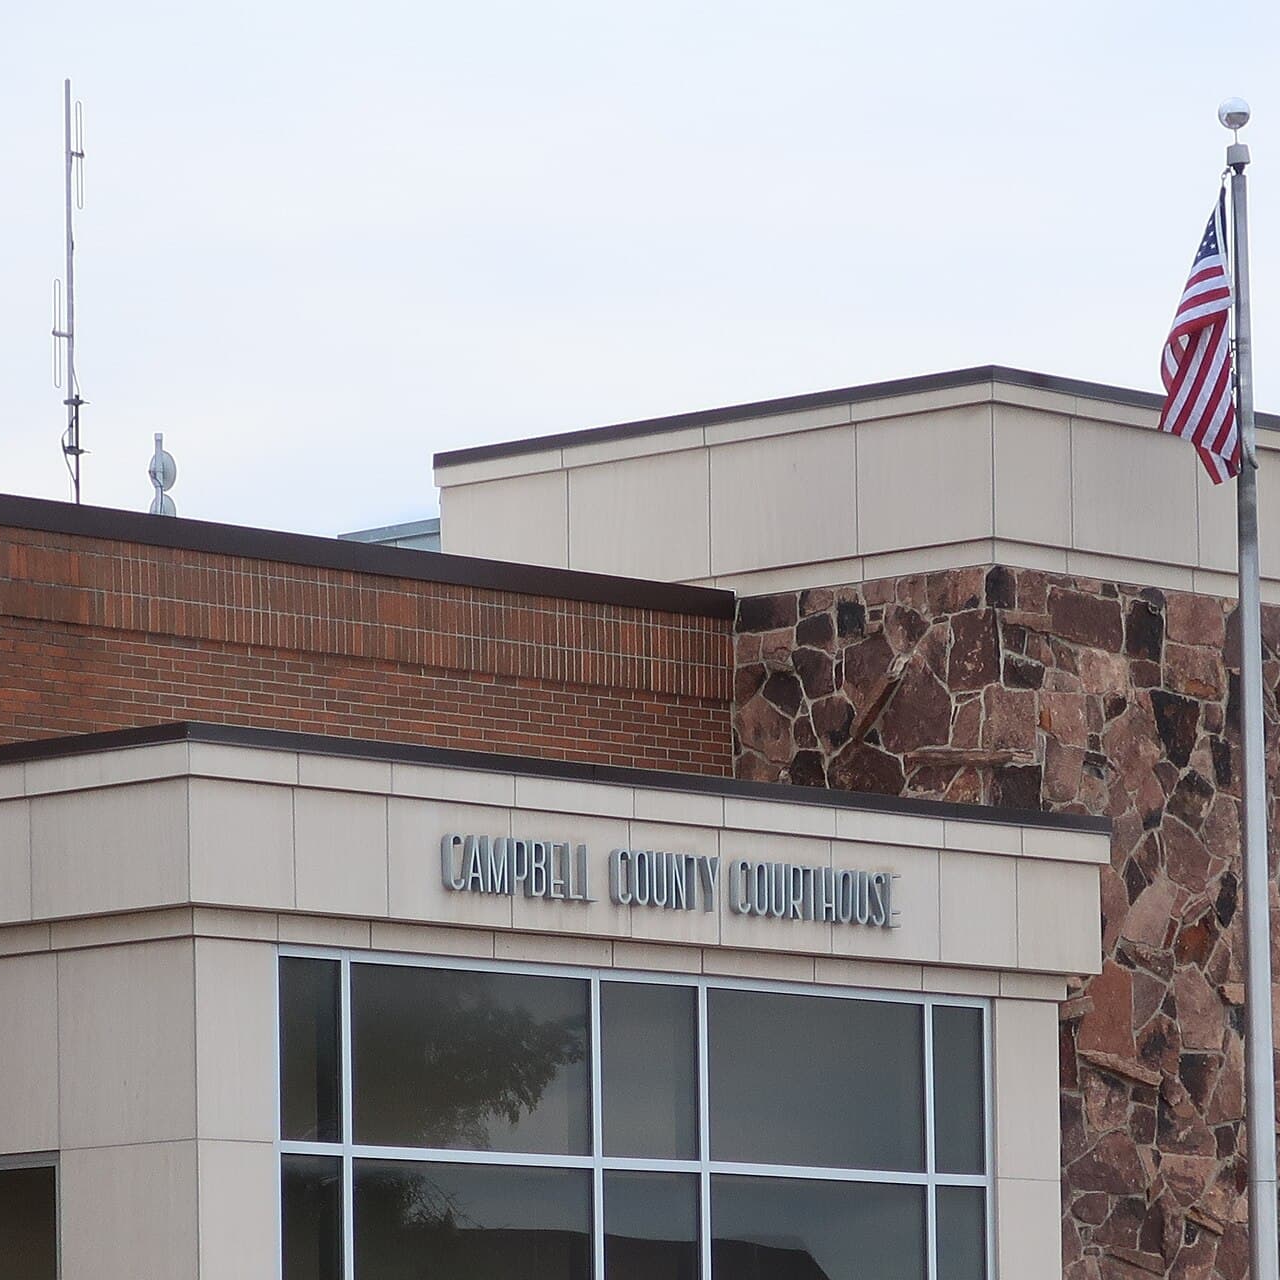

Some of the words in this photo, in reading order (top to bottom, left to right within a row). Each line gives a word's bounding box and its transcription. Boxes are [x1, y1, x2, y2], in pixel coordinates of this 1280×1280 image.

[442, 833, 596, 902] CAMPBELL
[609, 848, 719, 913] COUNTY
[729, 858, 901, 928] COURTHOUSE
